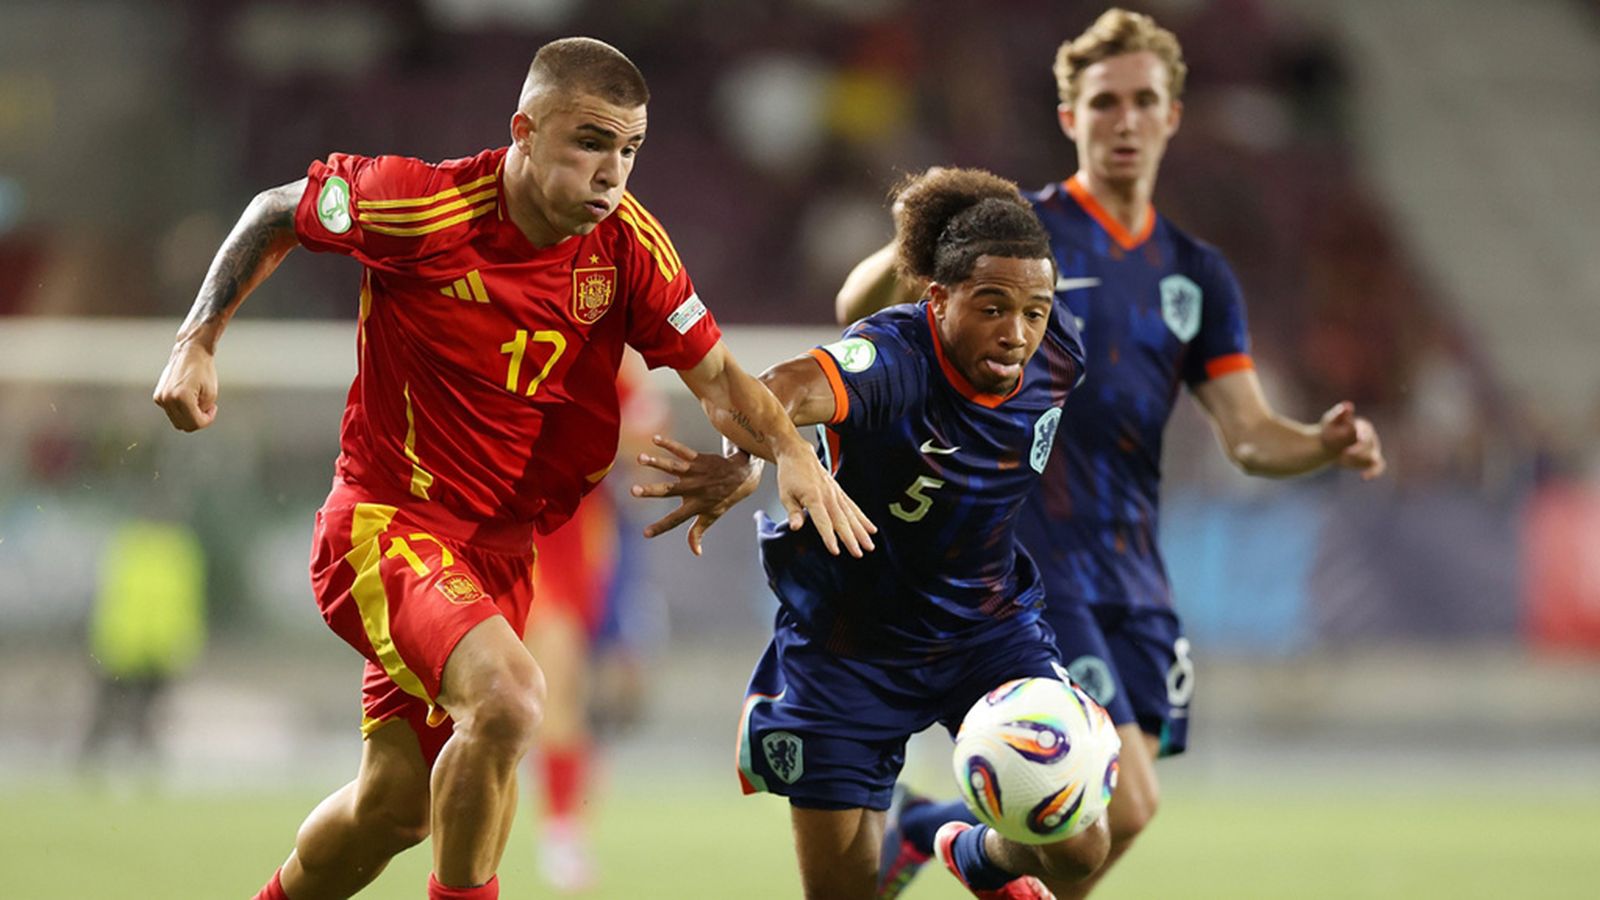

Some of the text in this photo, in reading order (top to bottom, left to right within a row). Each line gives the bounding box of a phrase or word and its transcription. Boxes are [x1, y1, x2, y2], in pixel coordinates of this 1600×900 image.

[500, 329, 567, 397] 17
[888, 475, 946, 522] 5
[384, 532, 455, 578] 17
